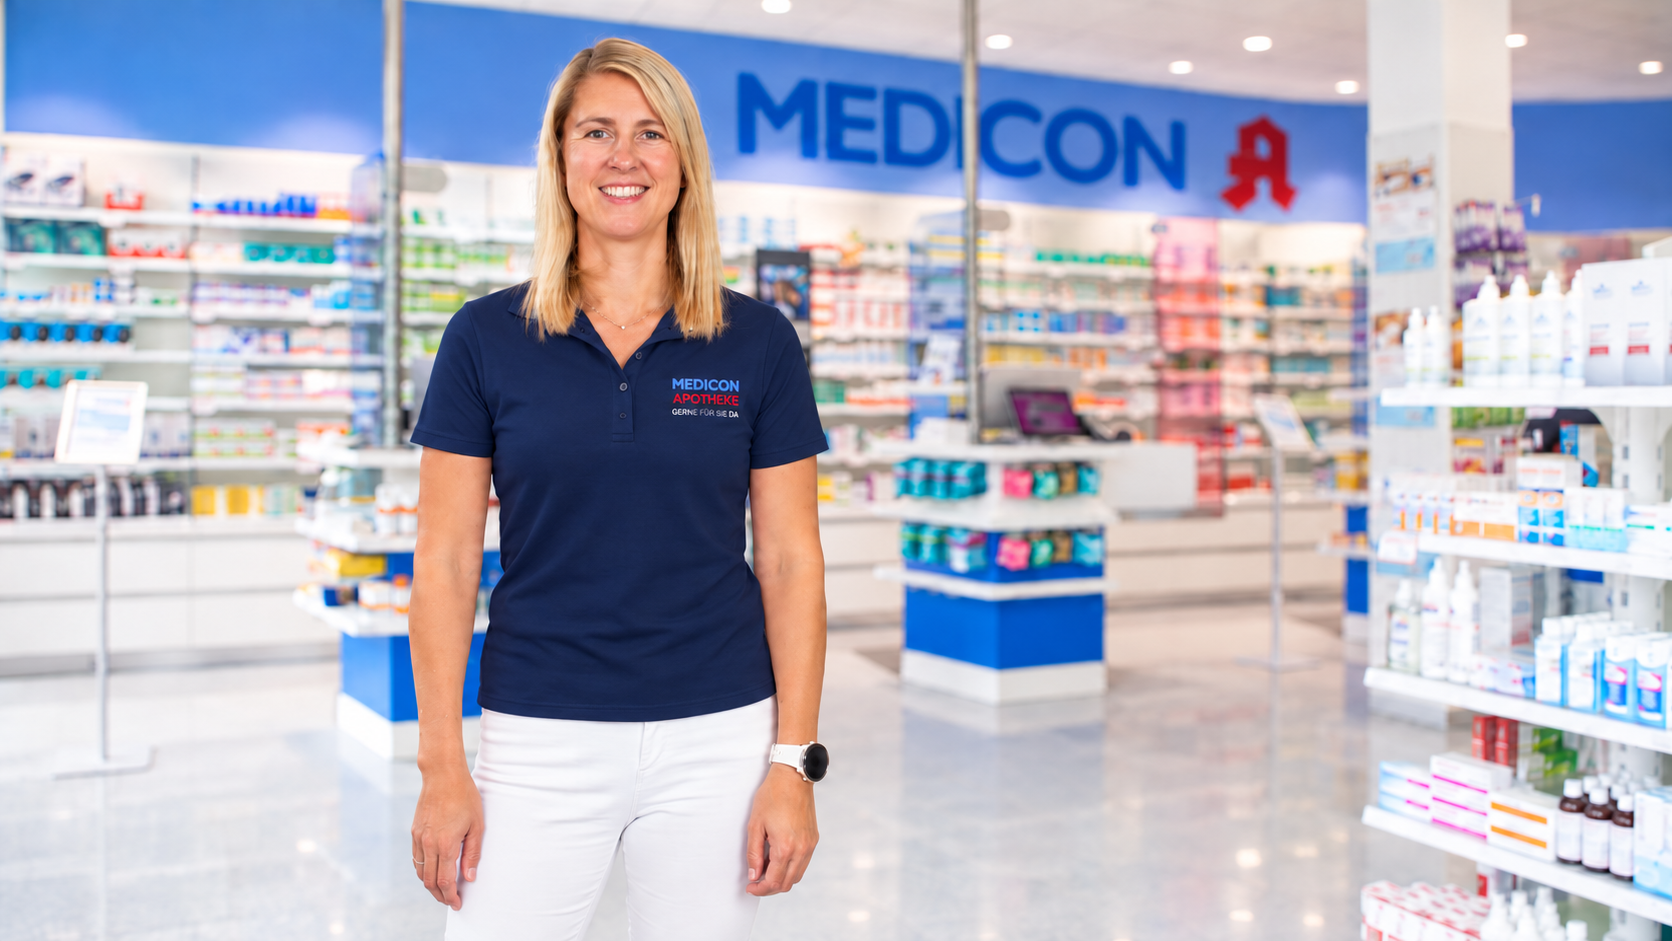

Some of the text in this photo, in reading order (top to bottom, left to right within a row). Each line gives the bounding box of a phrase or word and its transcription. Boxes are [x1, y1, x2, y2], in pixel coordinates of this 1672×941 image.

[672, 378, 739, 392] MEDICON
[673, 393, 739, 406] APOTHEKE
[672, 408, 698, 416] GERNE
[728, 410, 739, 418] DA
